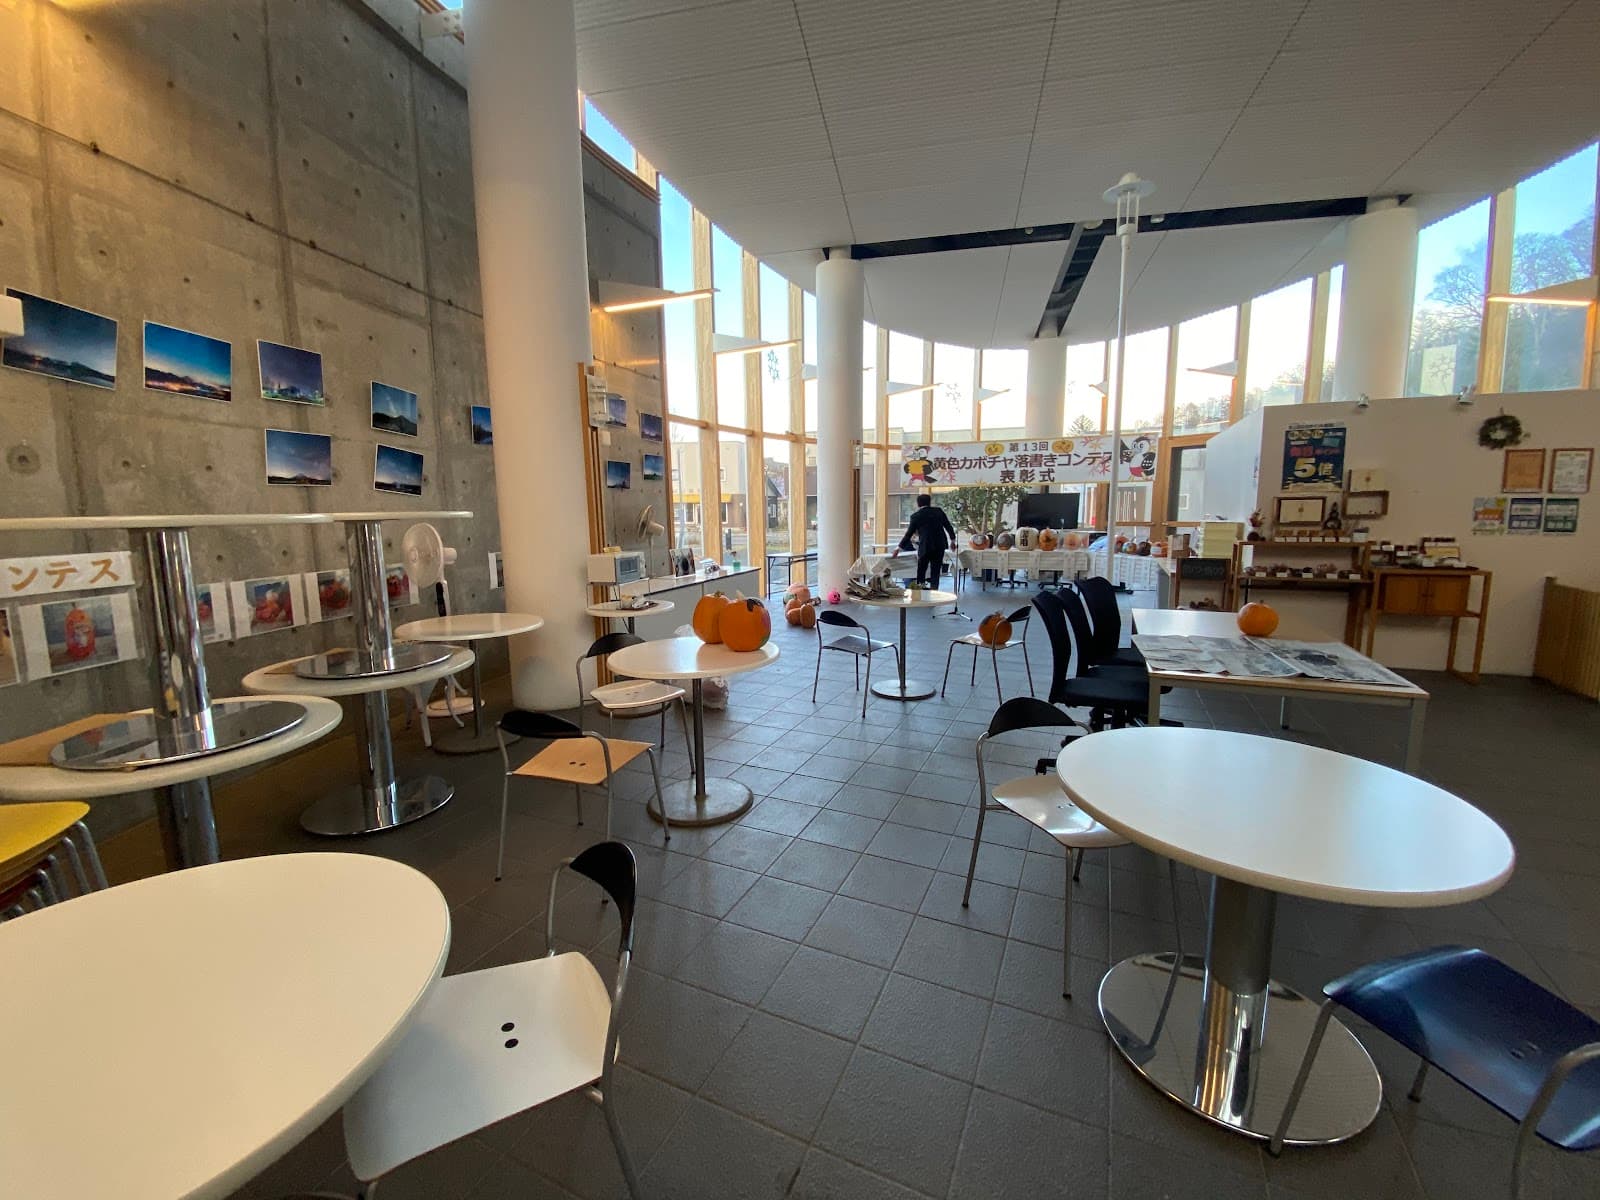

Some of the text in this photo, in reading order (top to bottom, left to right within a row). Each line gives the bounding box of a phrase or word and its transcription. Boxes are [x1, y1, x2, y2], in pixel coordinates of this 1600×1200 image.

[999, 468, 1055, 484] 表彰式
[8, 558, 120, 592] ンテス
